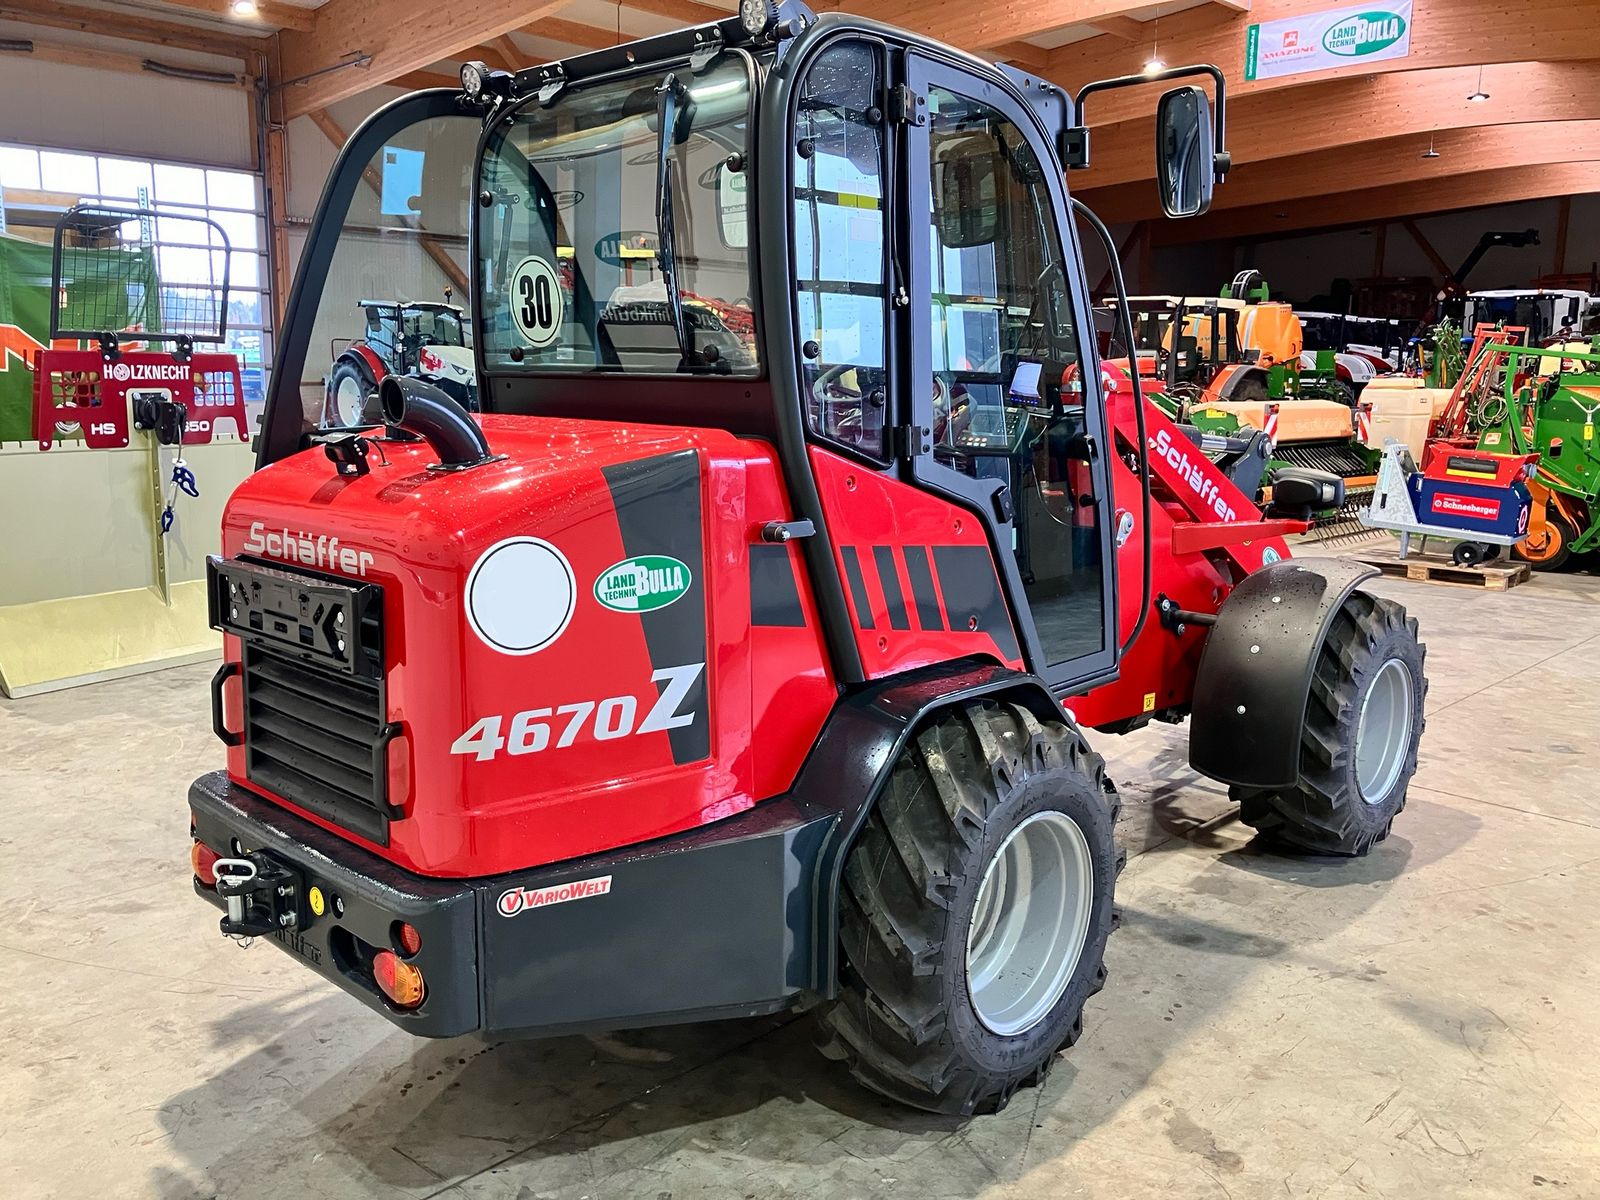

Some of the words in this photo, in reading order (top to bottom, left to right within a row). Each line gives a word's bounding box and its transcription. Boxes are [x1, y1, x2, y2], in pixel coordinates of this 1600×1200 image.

[1332, 26, 1357, 39] LAND
[1357, 18, 1399, 44] BULLA
[1329, 38, 1356, 48] TECHNIK
[1263, 45, 1316, 59] AMAZONE
[519, 274, 553, 329] 30
[104, 363, 190, 381] HOLZKNECHT
[91, 422, 116, 435] HS
[1156, 430, 1236, 522] Schäffer
[1443, 500, 1498, 515] Schneeberger
[243, 522, 375, 576] Schäffer
[606, 573, 636, 590] LAND
[636, 564, 684, 597] BULLA
[604, 588, 638, 601] TECHNIK
